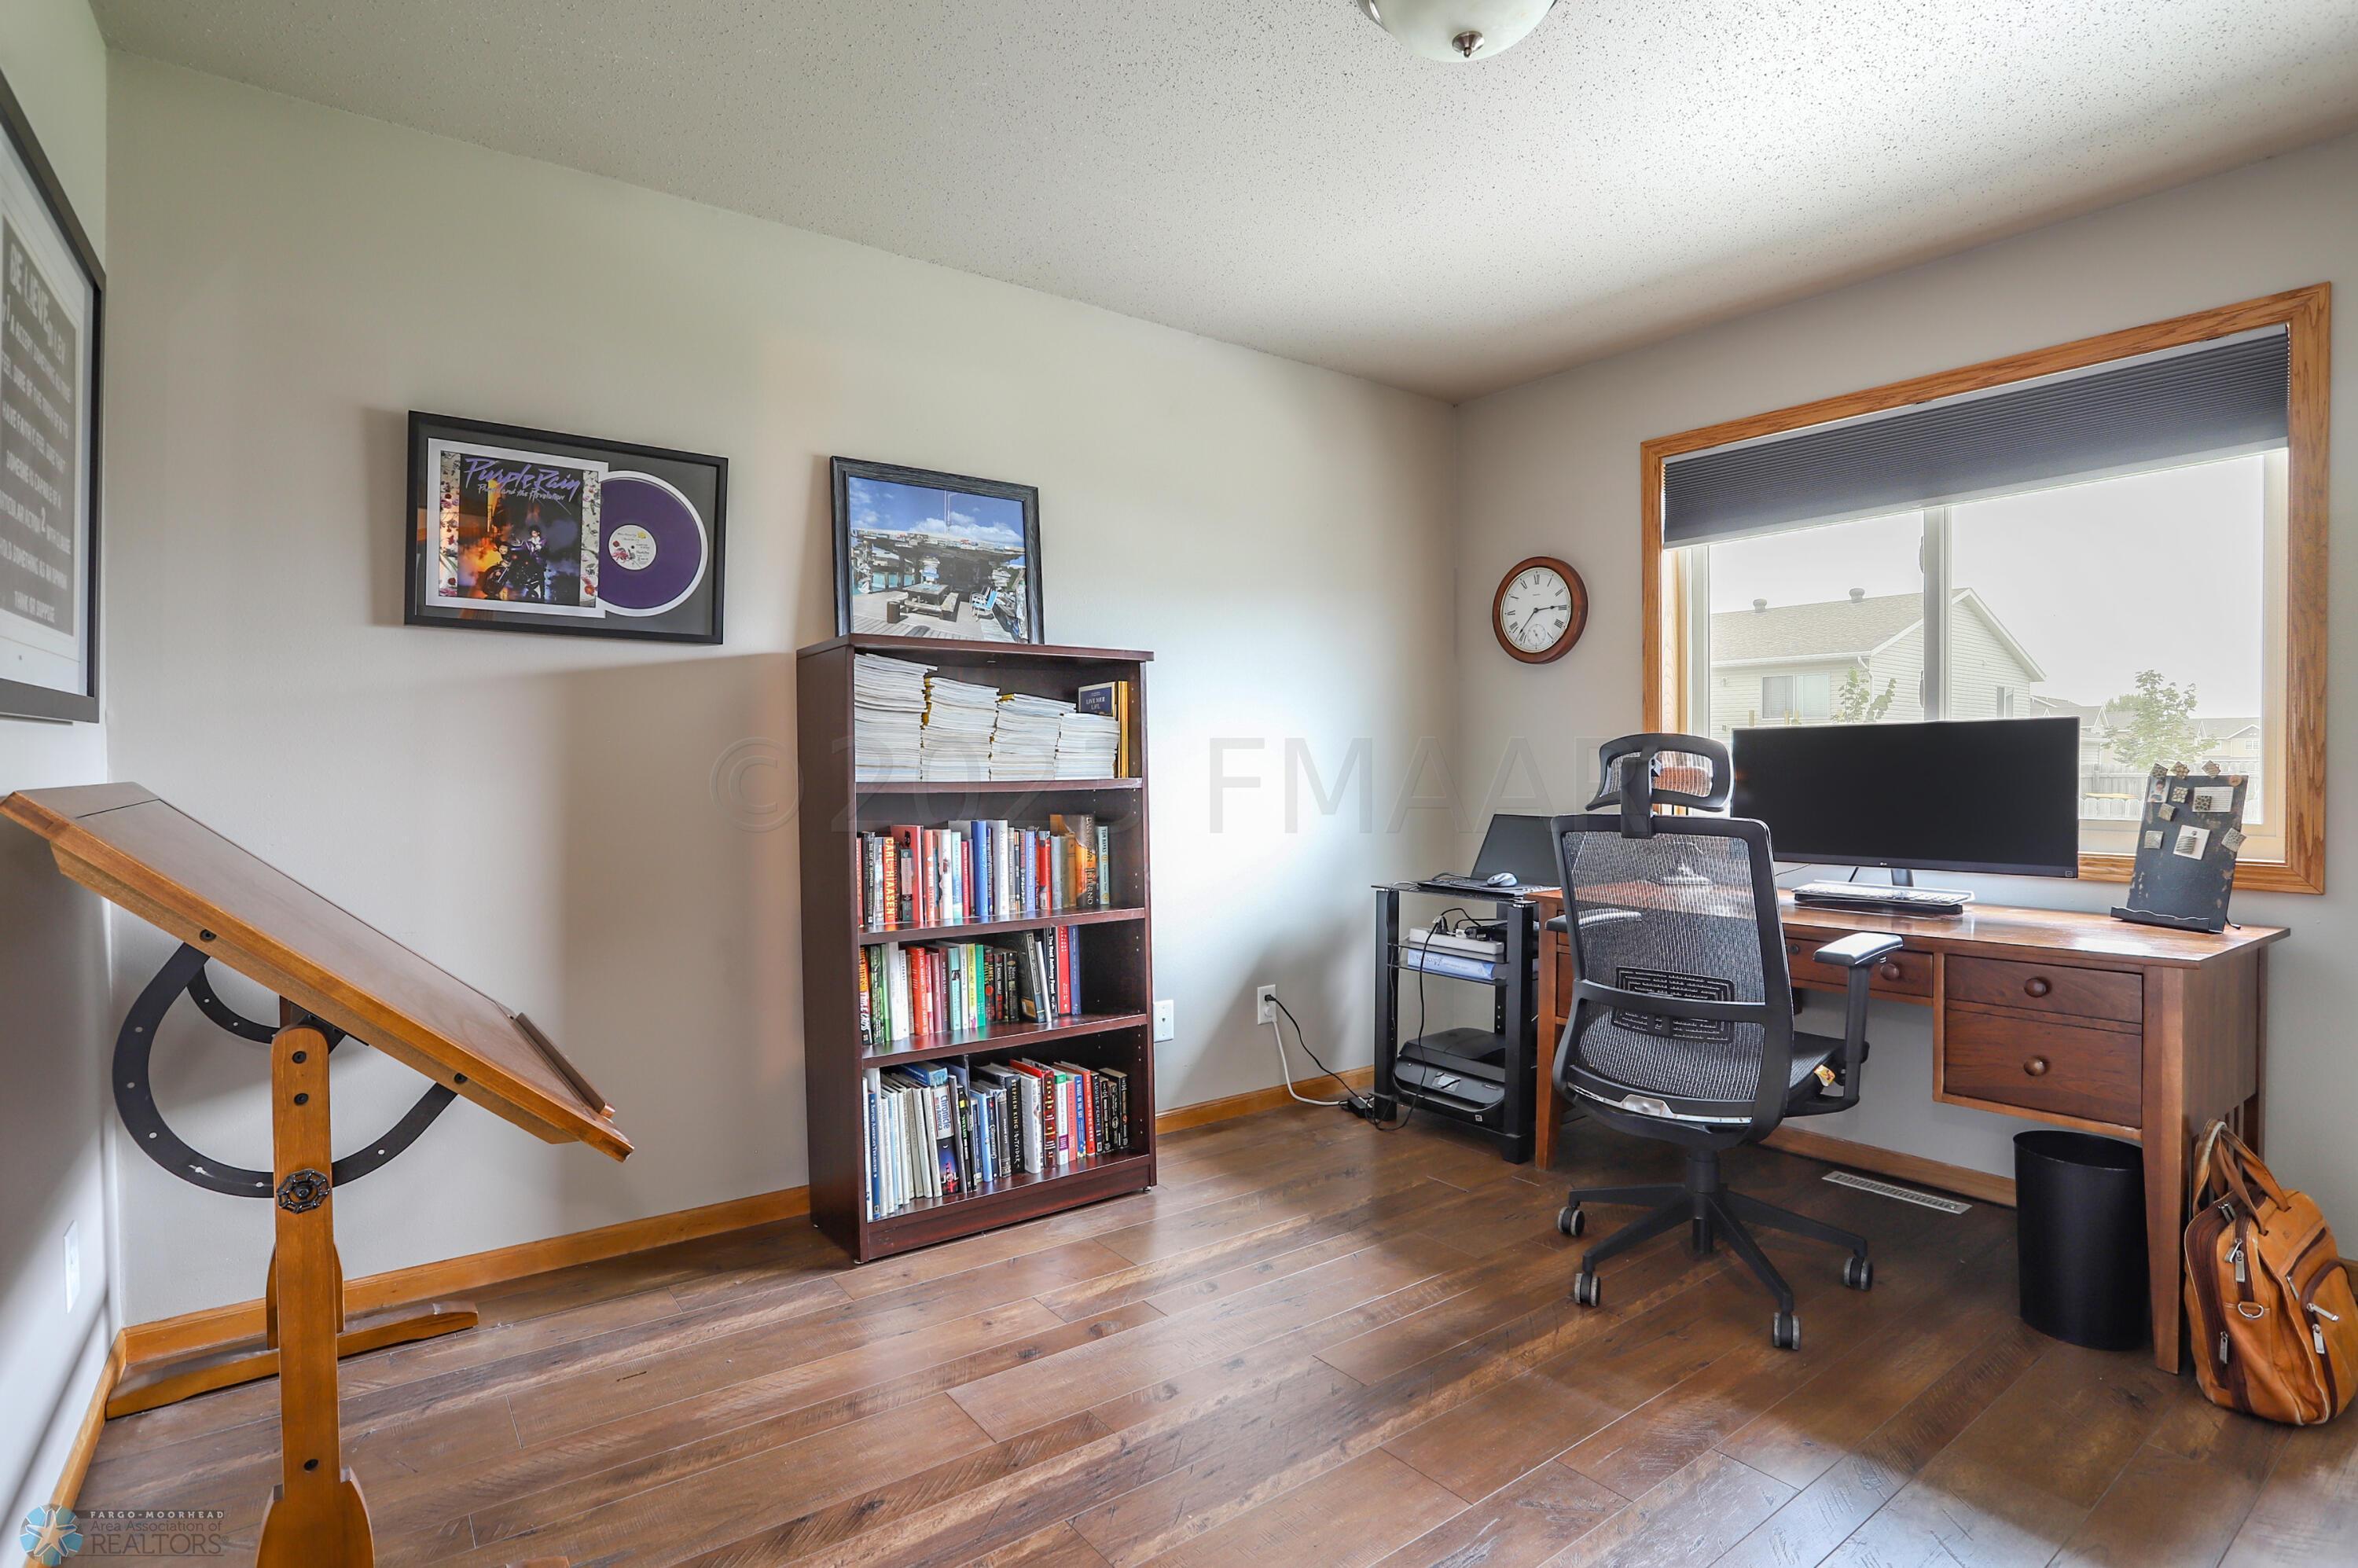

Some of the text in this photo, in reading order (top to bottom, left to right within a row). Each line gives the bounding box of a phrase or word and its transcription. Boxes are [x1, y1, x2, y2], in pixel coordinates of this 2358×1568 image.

[464, 457, 581, 503] Purple Rain
[885, 838, 894, 863] CARL
[886, 871, 895, 915] HIAASEN
[940, 1095, 952, 1129] Chronicle
